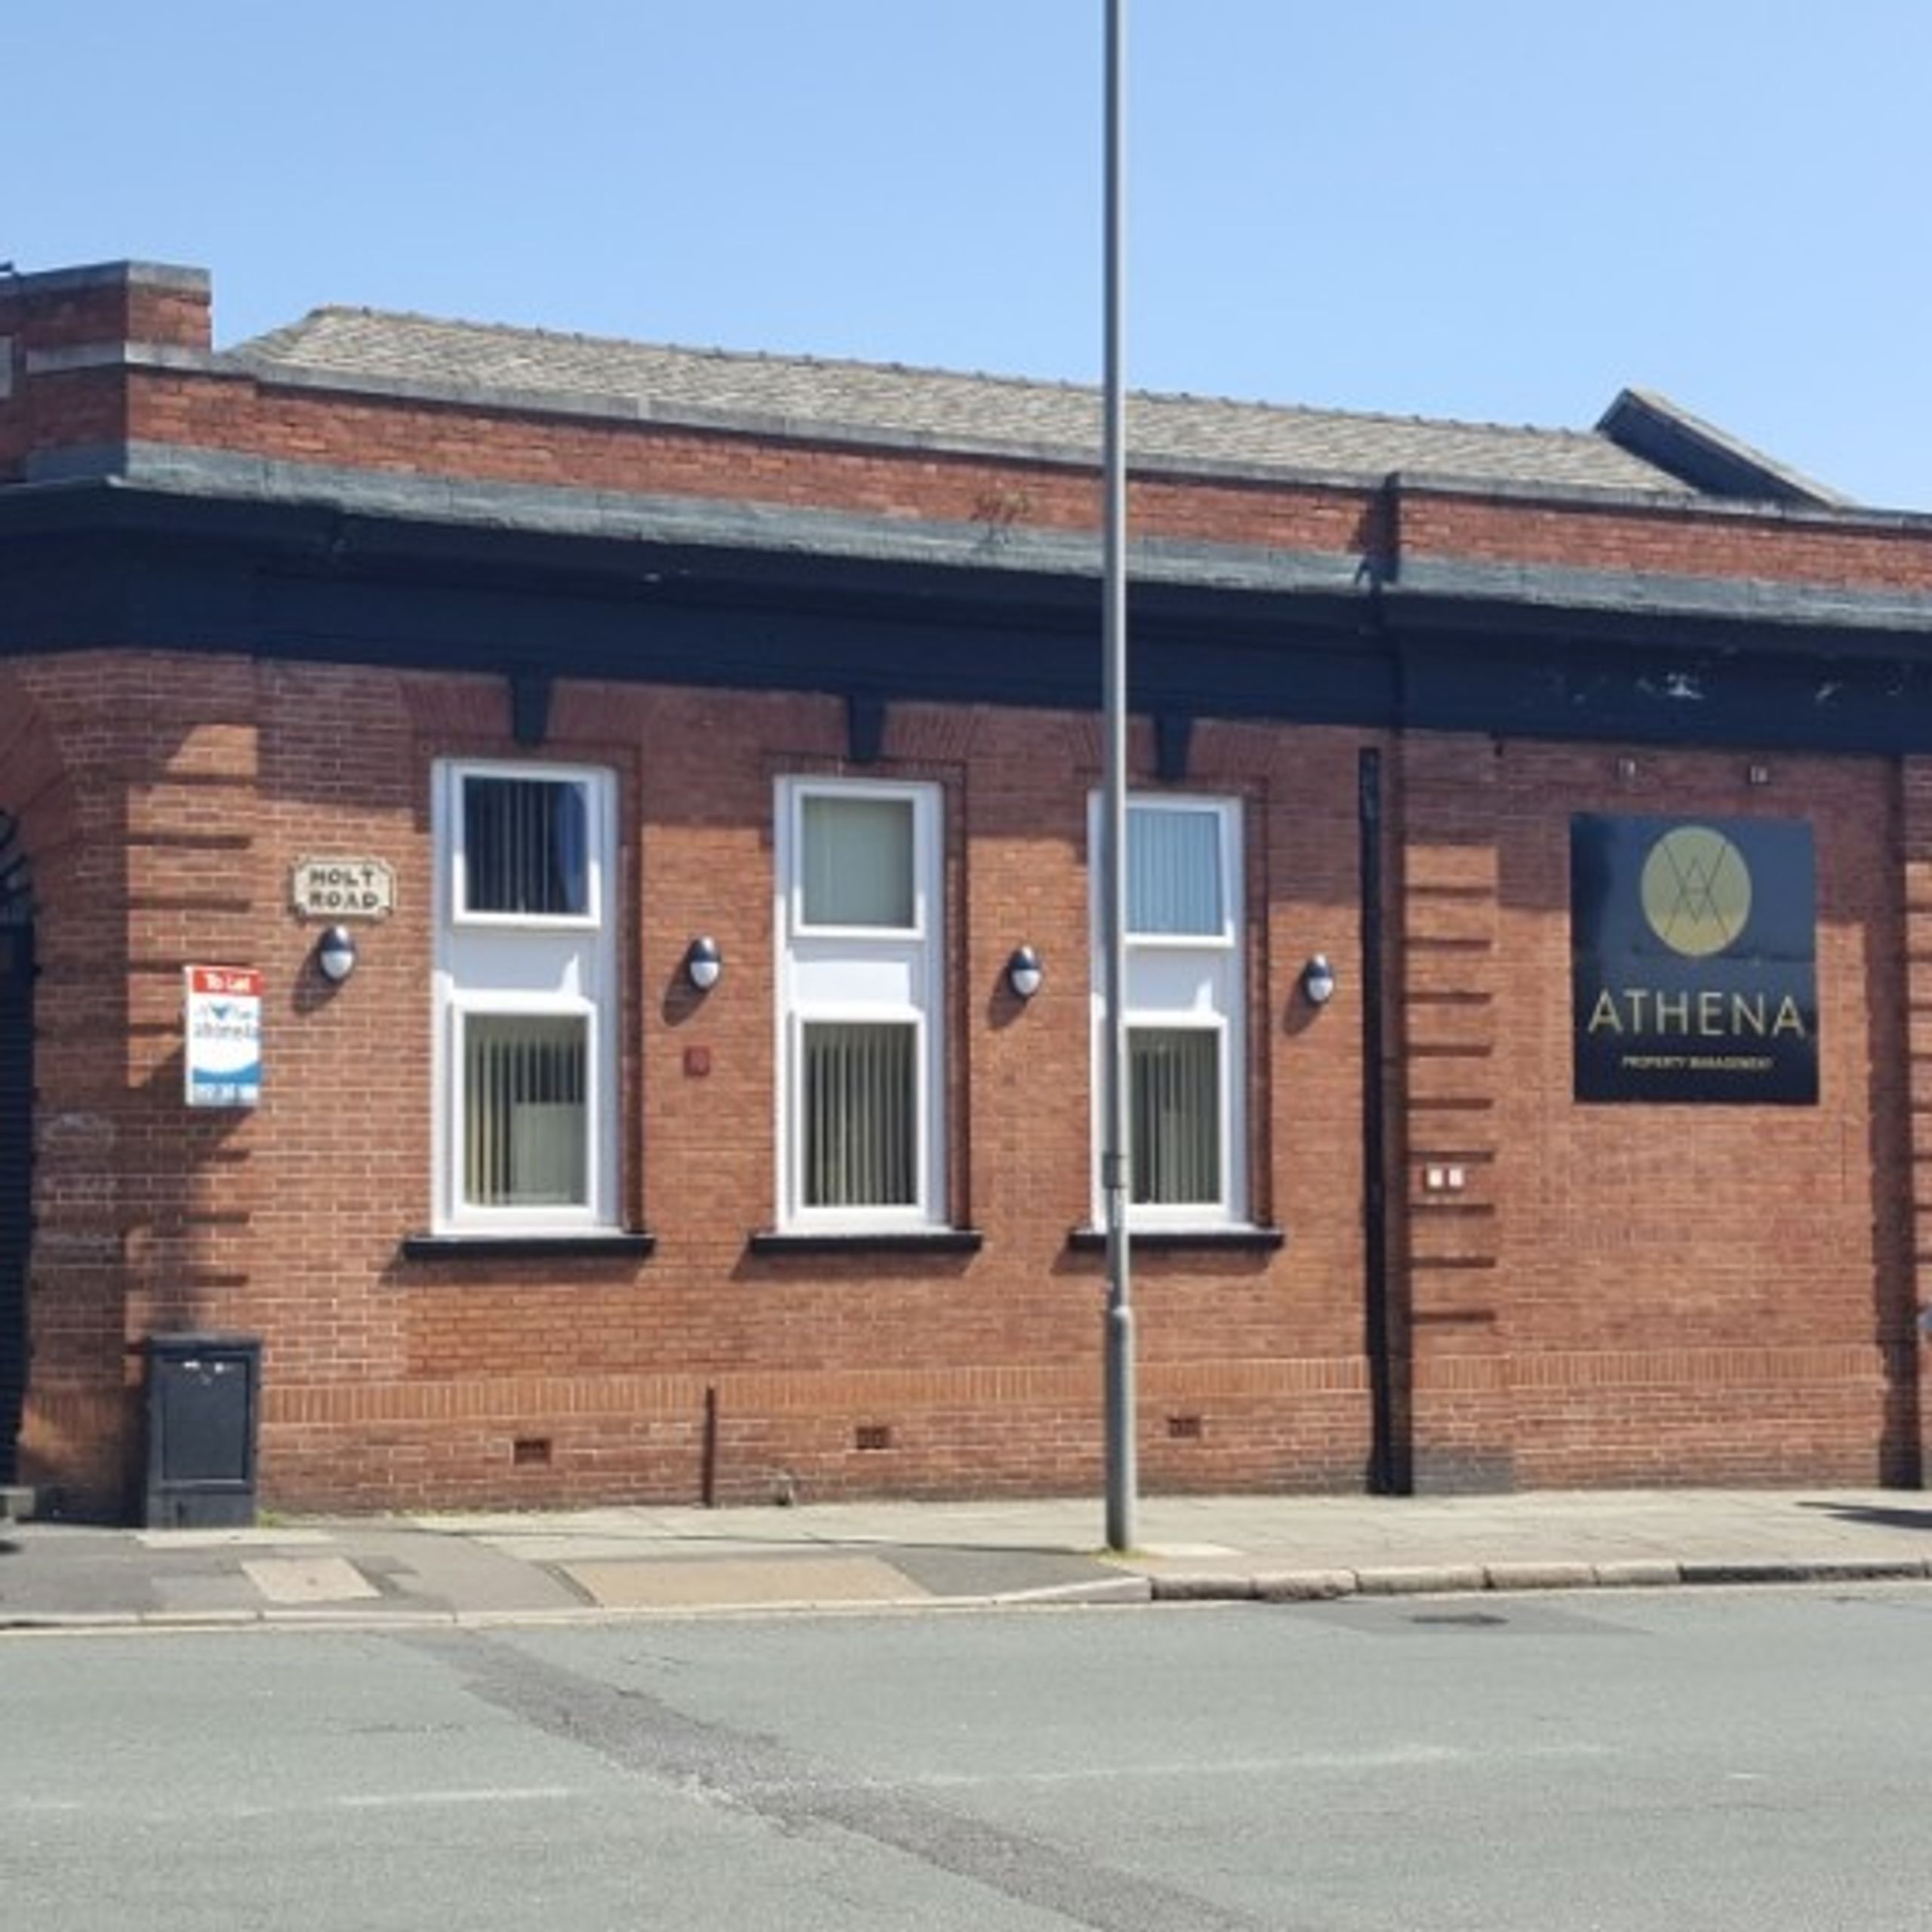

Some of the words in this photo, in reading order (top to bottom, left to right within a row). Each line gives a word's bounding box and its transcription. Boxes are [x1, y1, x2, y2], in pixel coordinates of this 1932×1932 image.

[309, 867, 374, 887] HOLT
[309, 891, 379, 909] ROAD
[204, 972, 224, 991] To
[1588, 988, 1805, 1038] ATHENA
